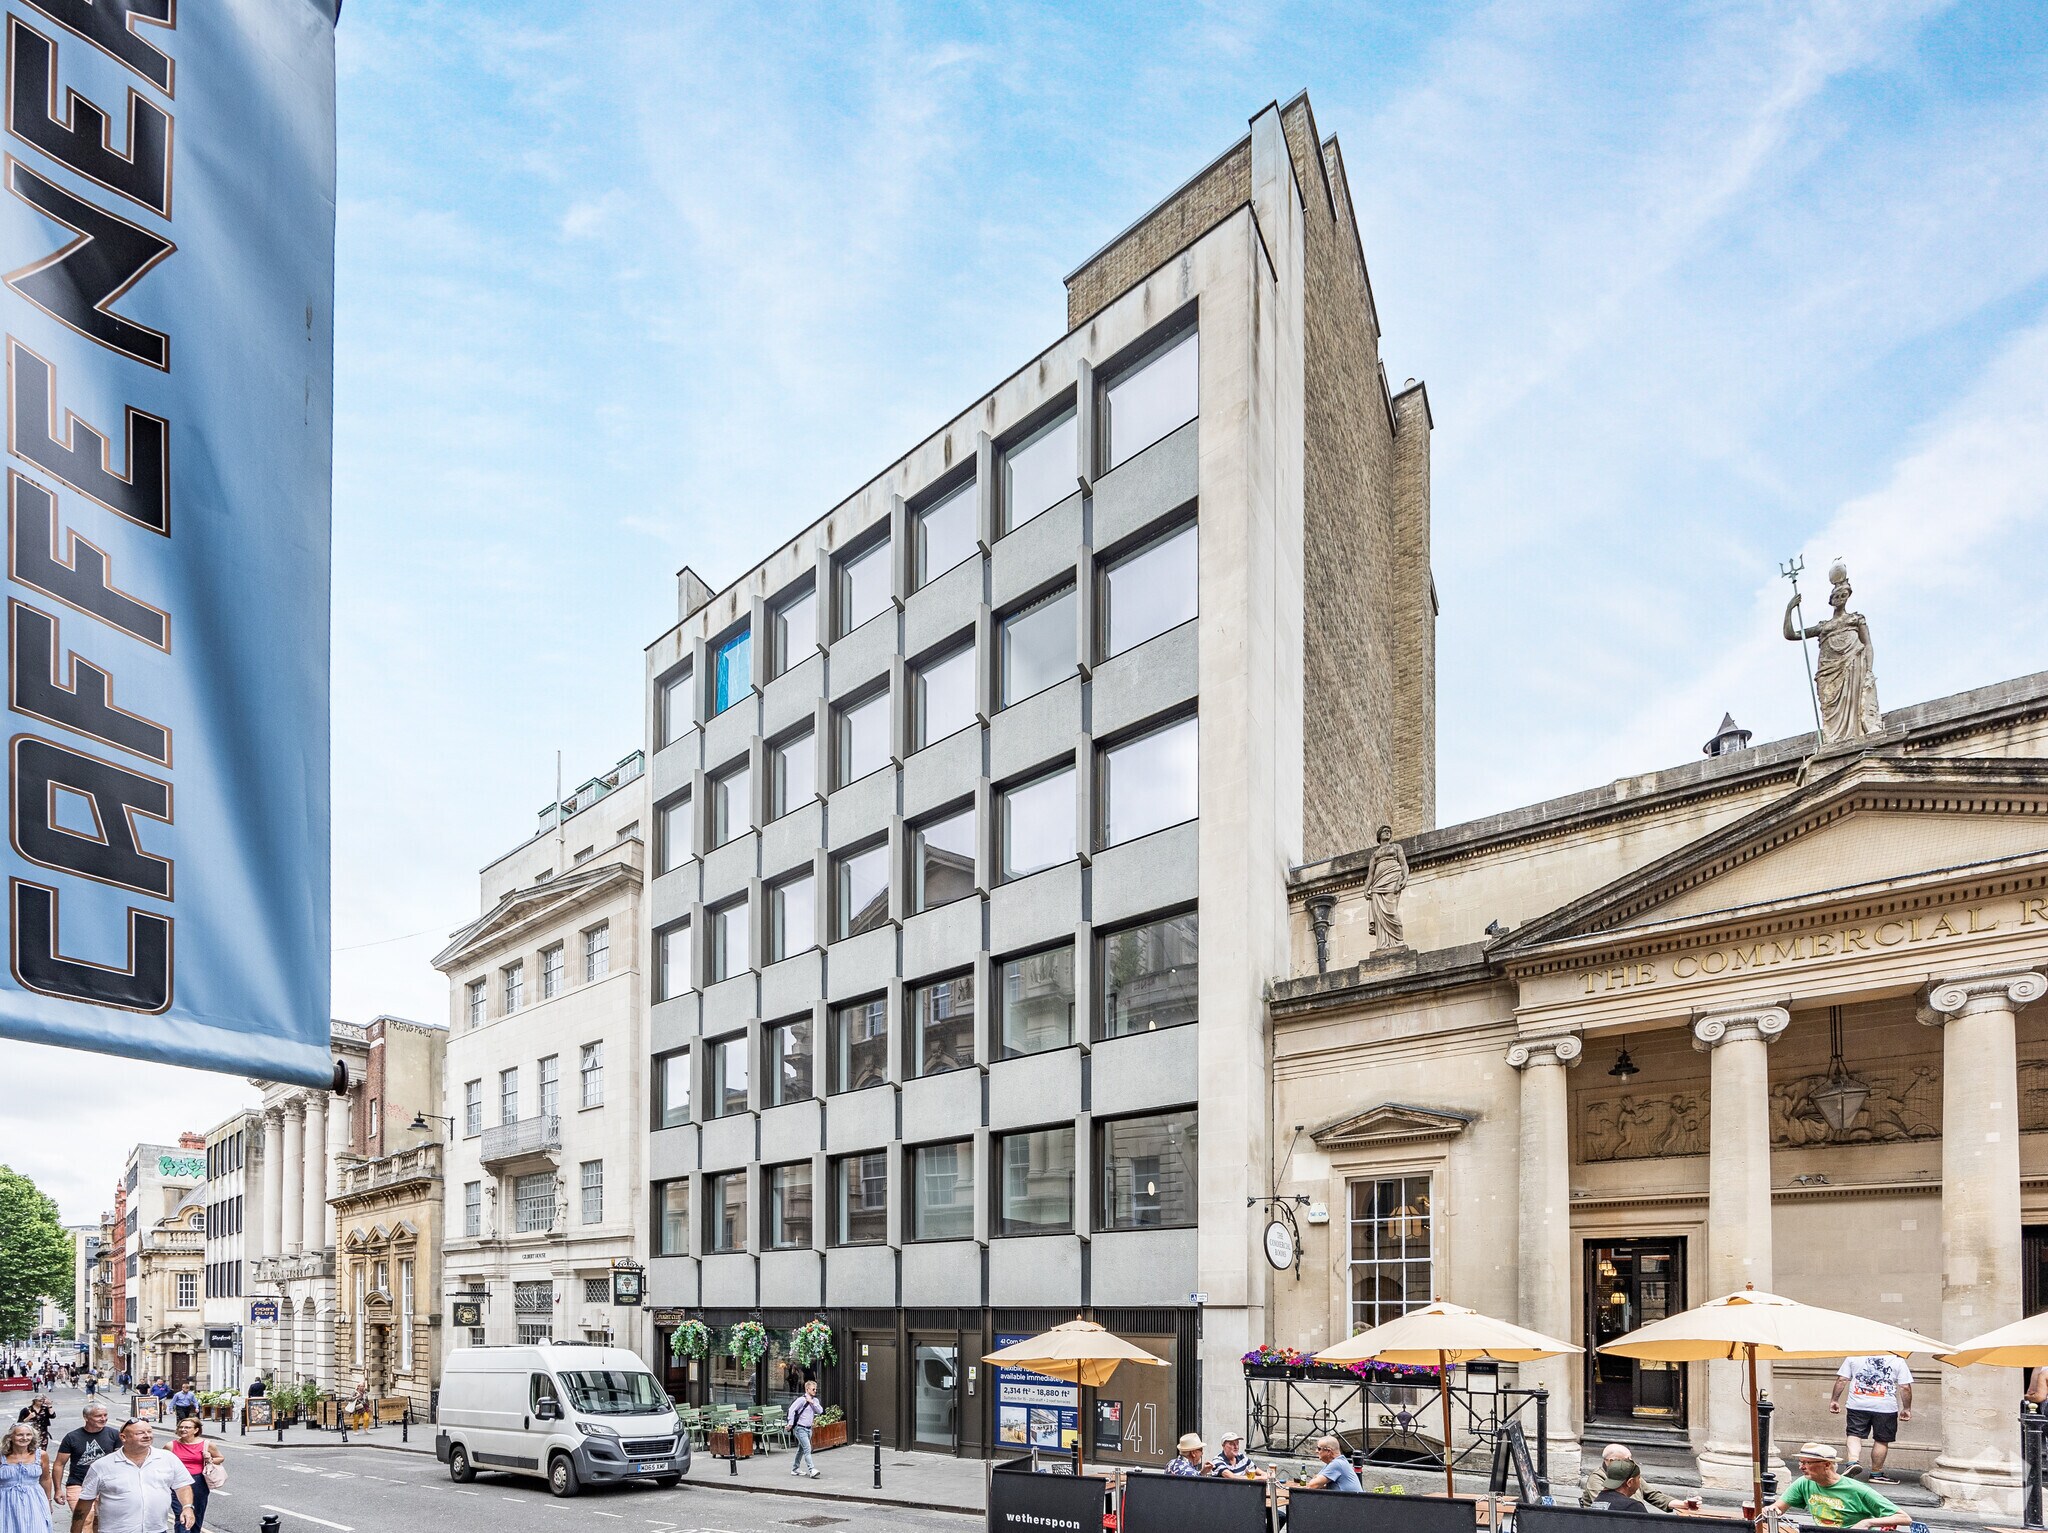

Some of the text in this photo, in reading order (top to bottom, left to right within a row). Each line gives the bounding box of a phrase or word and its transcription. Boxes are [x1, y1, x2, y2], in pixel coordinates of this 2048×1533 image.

[1579, 962, 1658, 994] THE
[1672, 907, 1999, 979] COMMERCIAL
[1003, 1386, 1021, 1395] 2,314
[1037, 1388, 1060, 1397] 18,880
[1005, 1513, 1080, 1530] wetherspoon
